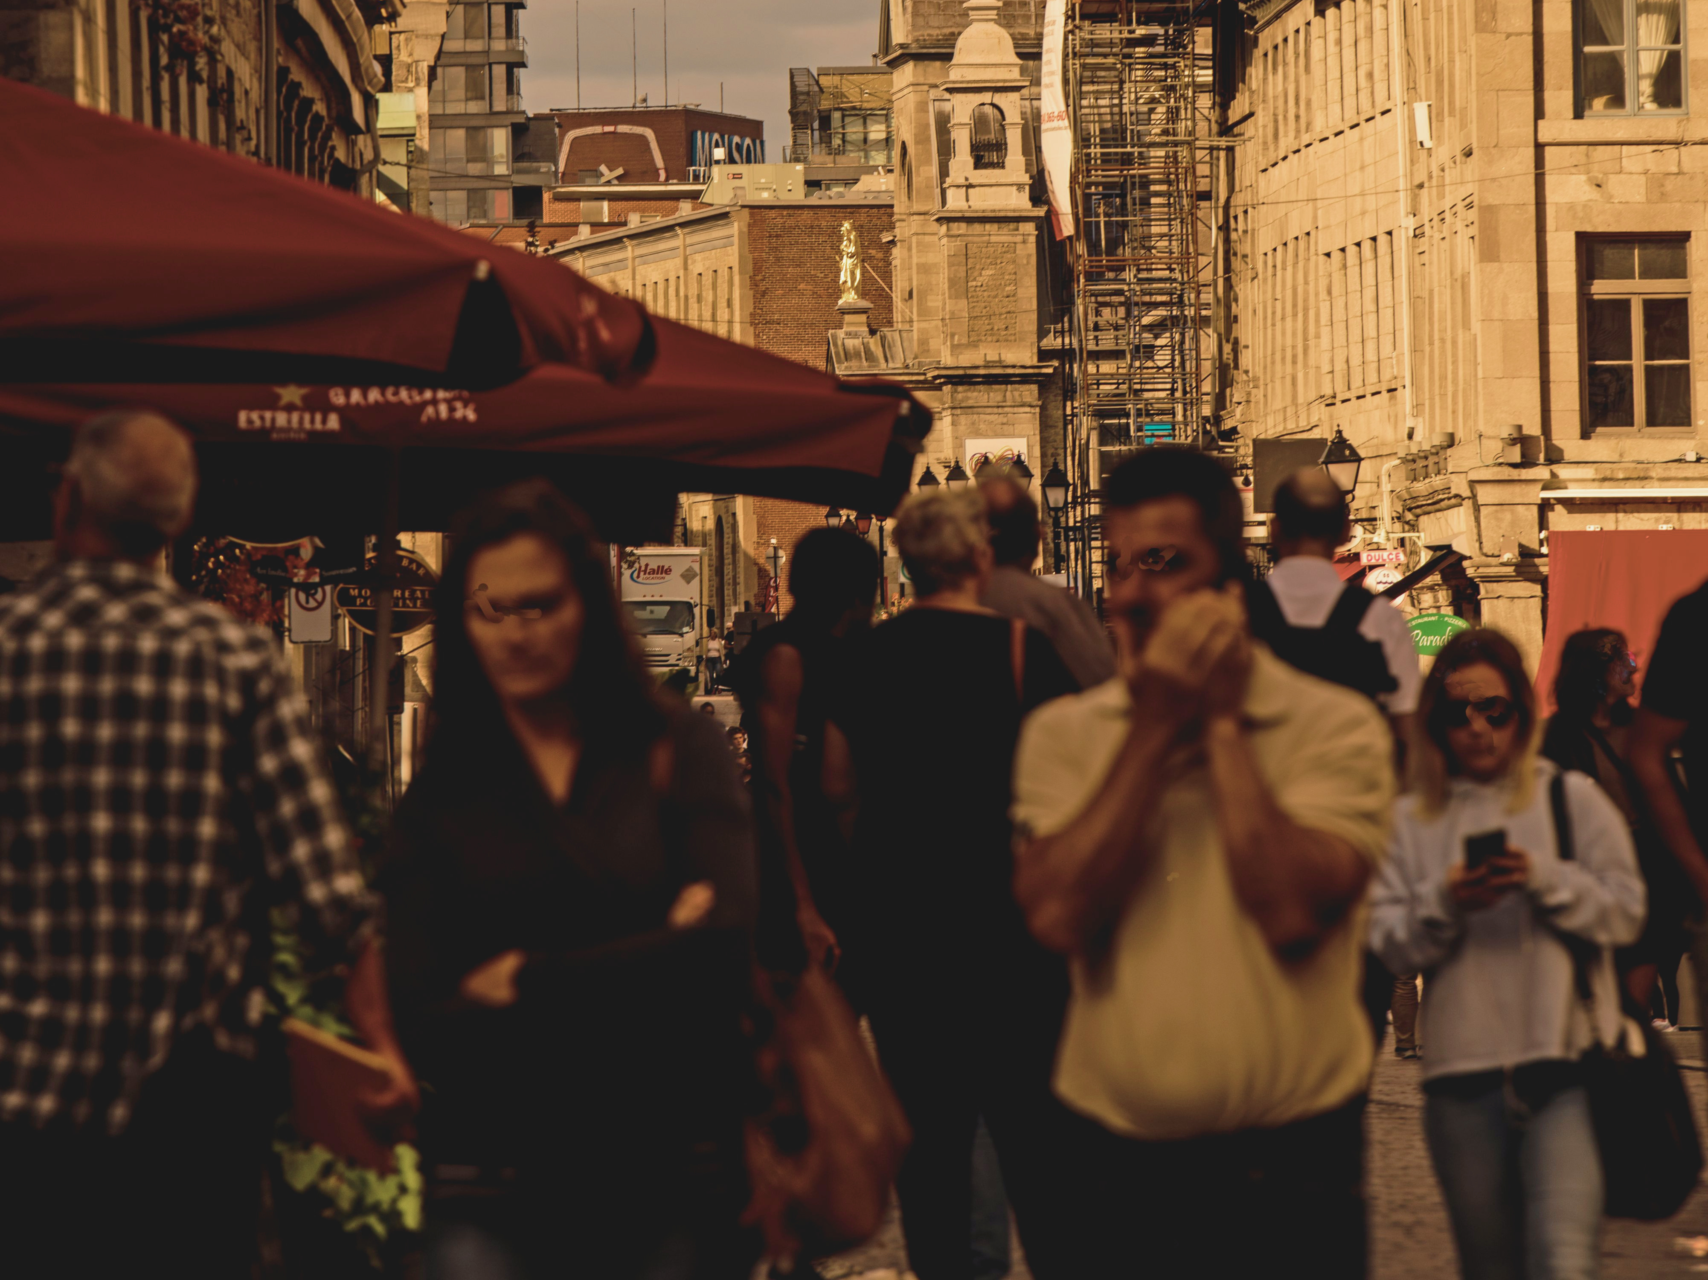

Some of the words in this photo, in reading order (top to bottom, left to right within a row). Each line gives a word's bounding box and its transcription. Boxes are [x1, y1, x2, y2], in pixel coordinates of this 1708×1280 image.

[237, 409, 342, 432] ESTRELLA
[1366, 551, 1402, 562] DULCE
[401, 557, 426, 577] BAR
[636, 563, 672, 579] Hallé
[348, 588, 431, 599] MOREAL
[356, 598, 424, 608] POTINE
[1407, 616, 1438, 627] ESTAURANT
[1410, 626, 1453, 647] Paradi
